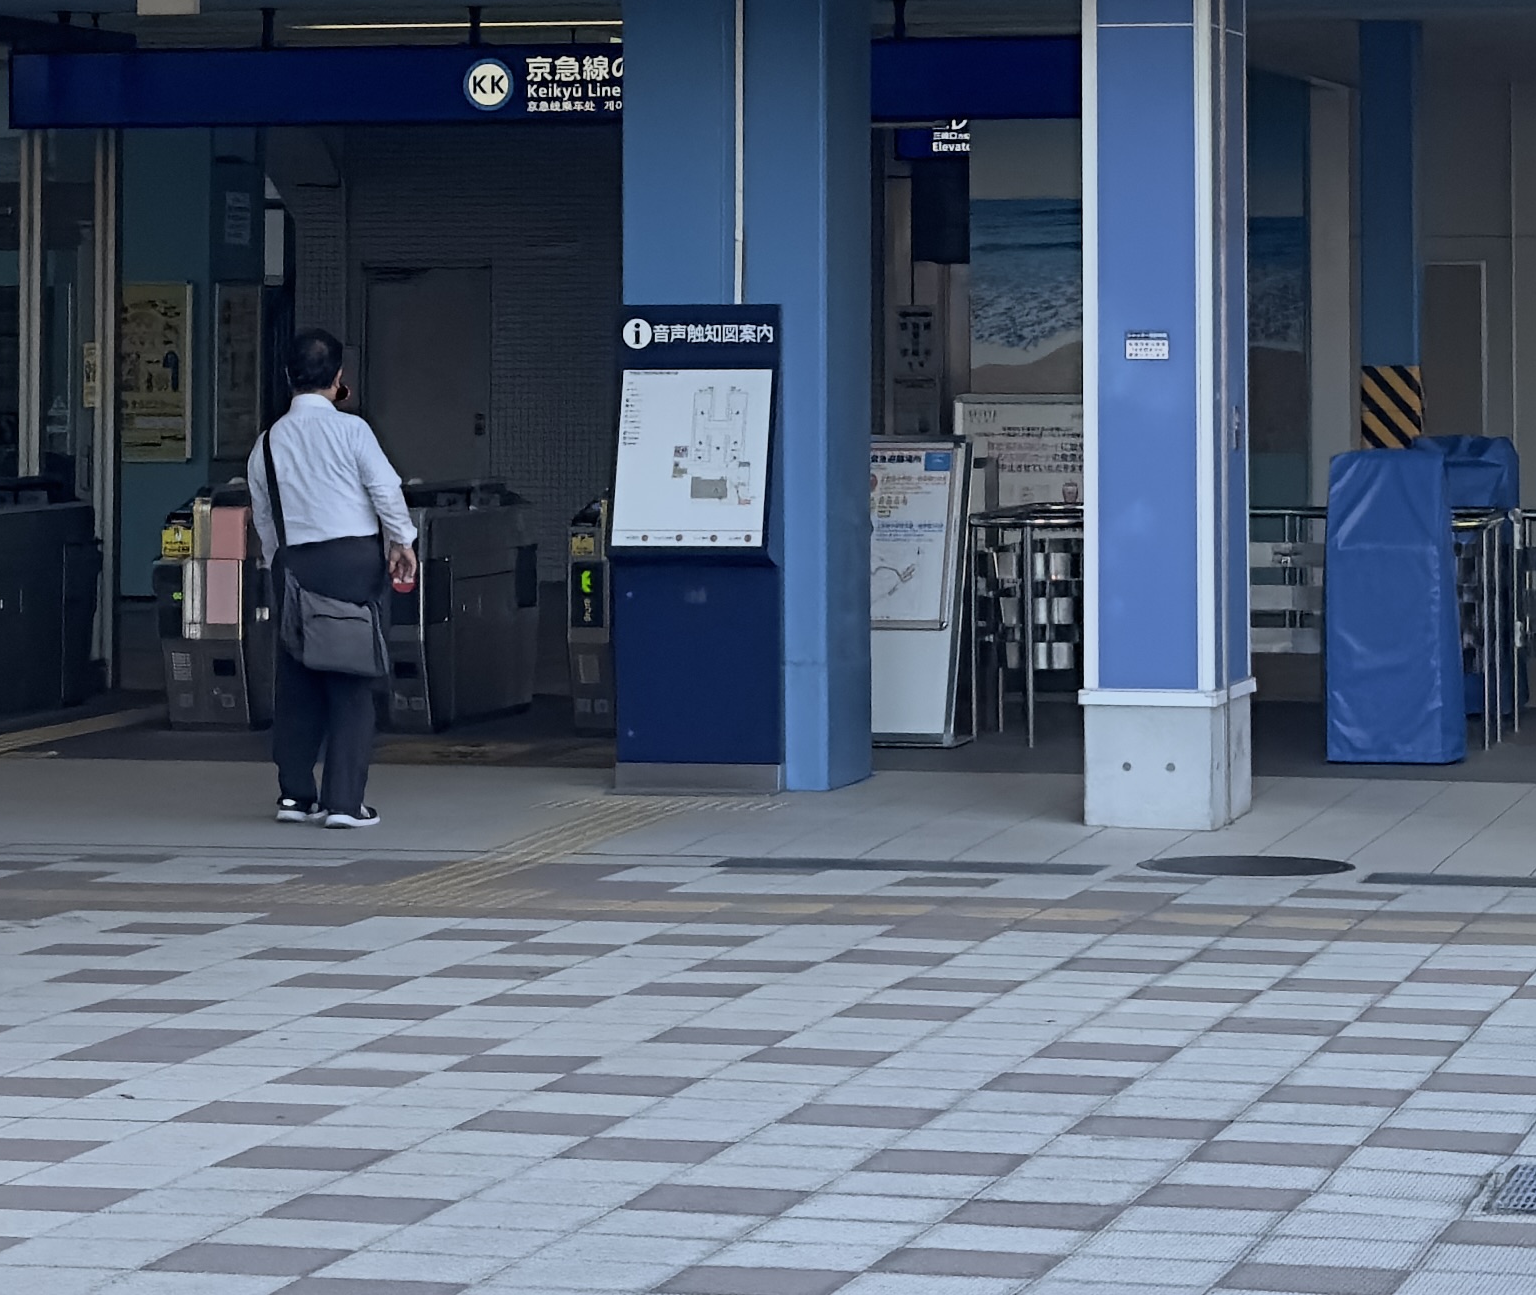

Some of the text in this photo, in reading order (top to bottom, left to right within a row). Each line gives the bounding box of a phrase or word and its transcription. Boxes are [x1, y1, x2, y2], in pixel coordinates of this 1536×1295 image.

[472, 74, 505, 95] KK
[527, 82, 621, 100] Keikyū Line
[653, 324, 774, 344] 音声触知図案内
